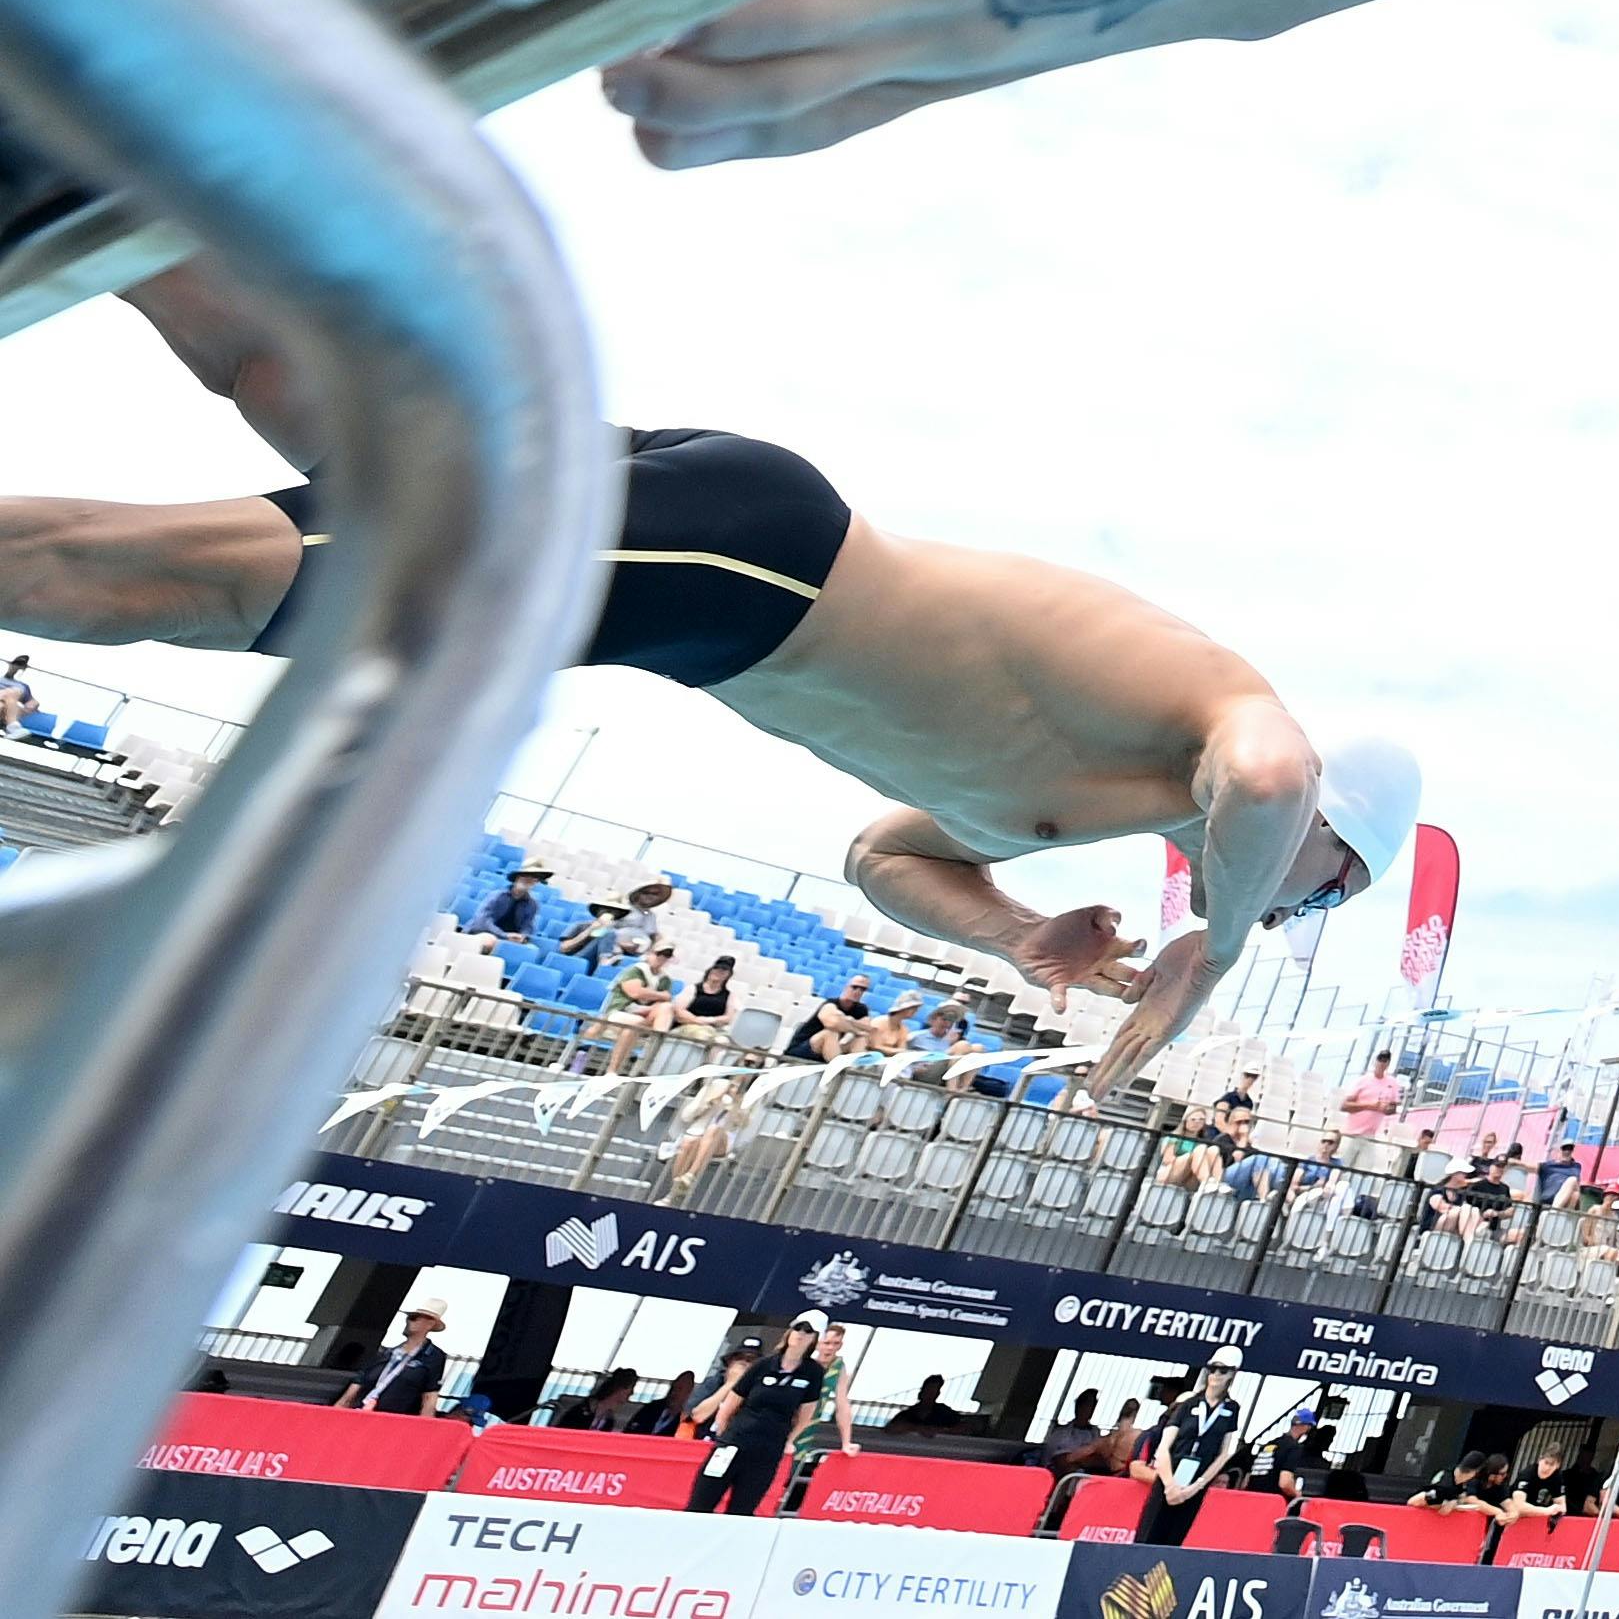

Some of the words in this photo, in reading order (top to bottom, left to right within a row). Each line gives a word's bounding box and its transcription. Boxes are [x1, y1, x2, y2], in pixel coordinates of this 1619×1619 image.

[273, 1181, 427, 1233] AUS
[621, 1230, 706, 1276] AIS
[1079, 1298, 1142, 1331] CITY
[1140, 1307, 1263, 1347] FERTILITY
[1312, 1317, 1375, 1345] TECH
[1297, 1348, 1439, 1386] mahindra
[1541, 1345, 1595, 1373] arena
[136, 1445, 288, 1478] AUSTRALIA'S
[487, 1466, 627, 1496] AUSTRALIA'S
[77, 1515, 222, 1568] rena
[448, 1514, 583, 1554] TECH
[411, 1568, 731, 1619] mahindra
[822, 1570, 892, 1600] CITY
[896, 1575, 1037, 1610] FERTILITY
[1186, 1576, 1268, 1619] AIS
